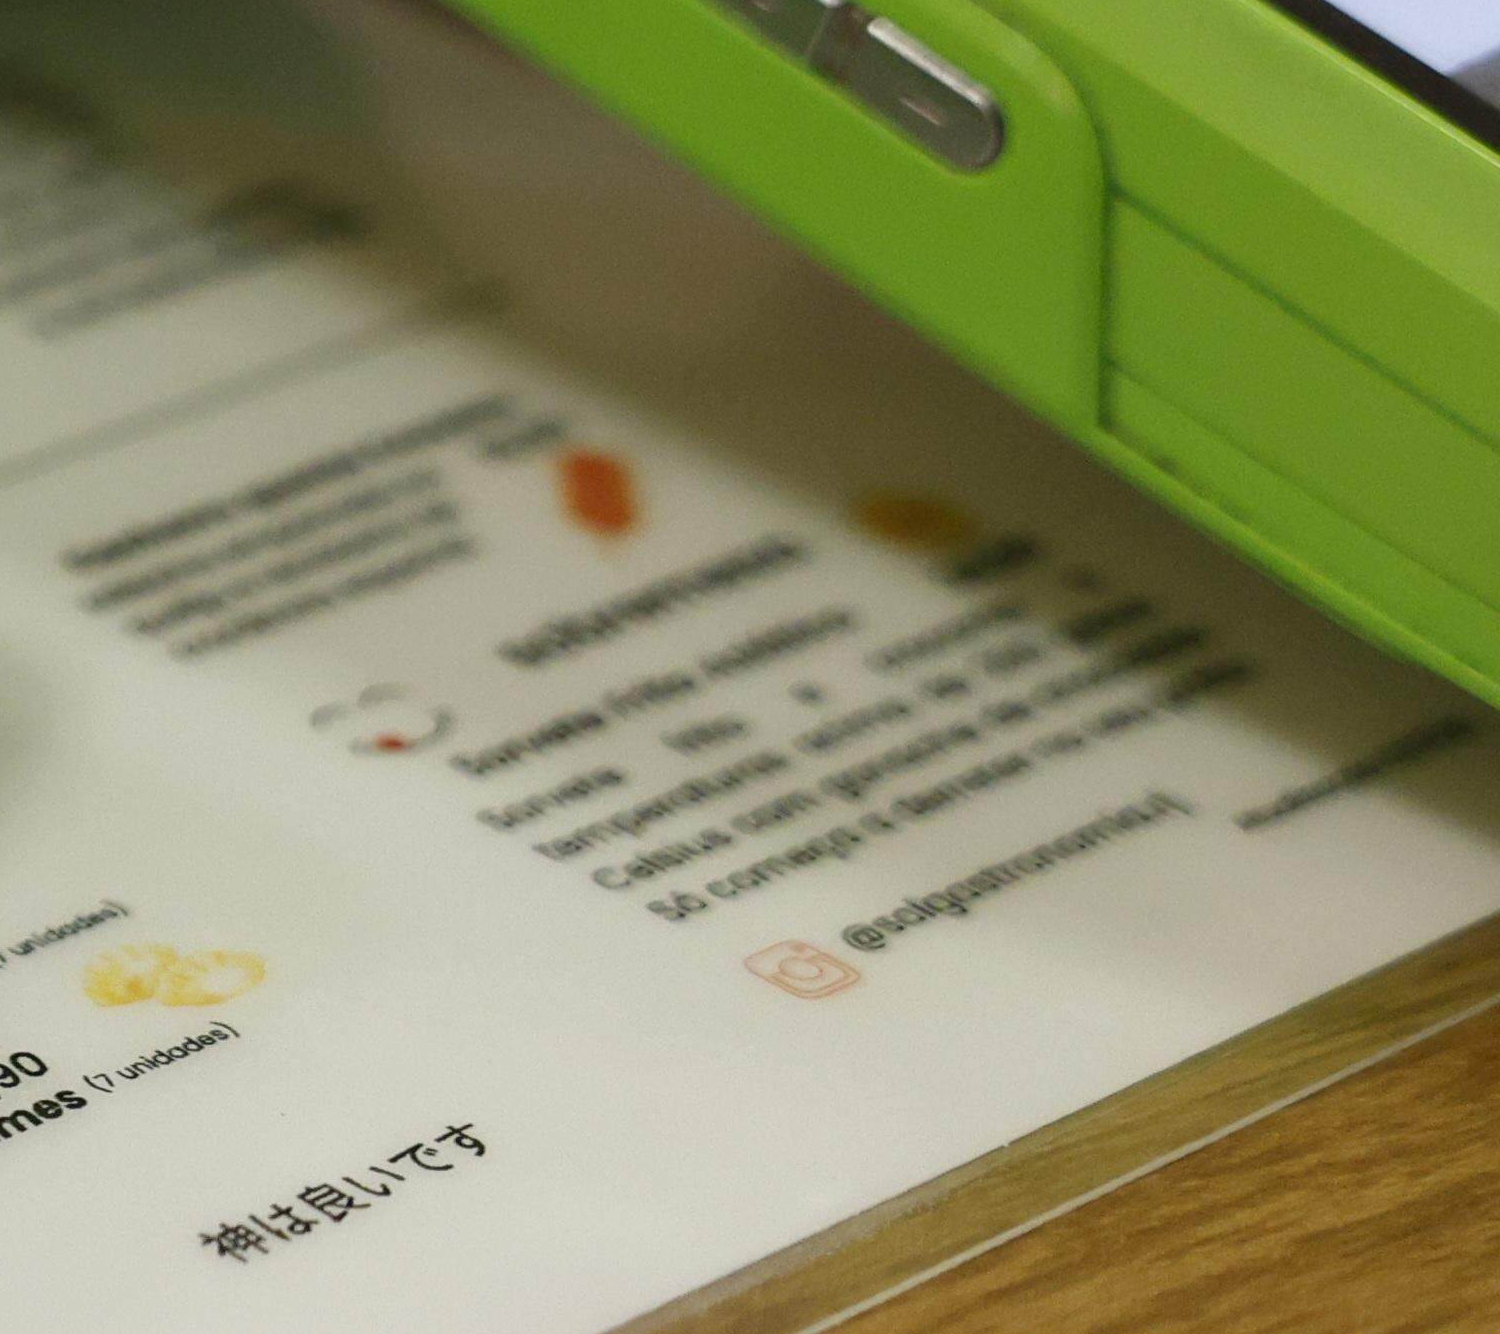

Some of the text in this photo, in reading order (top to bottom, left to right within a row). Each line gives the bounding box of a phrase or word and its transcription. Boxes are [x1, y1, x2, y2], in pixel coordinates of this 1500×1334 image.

[9, 900, 130, 958] unidades)
[82, 1072, 113, 1094] (7
[115, 1021, 240, 1081] unidades)
[199, 1123, 486, 1263] 神は良いです
